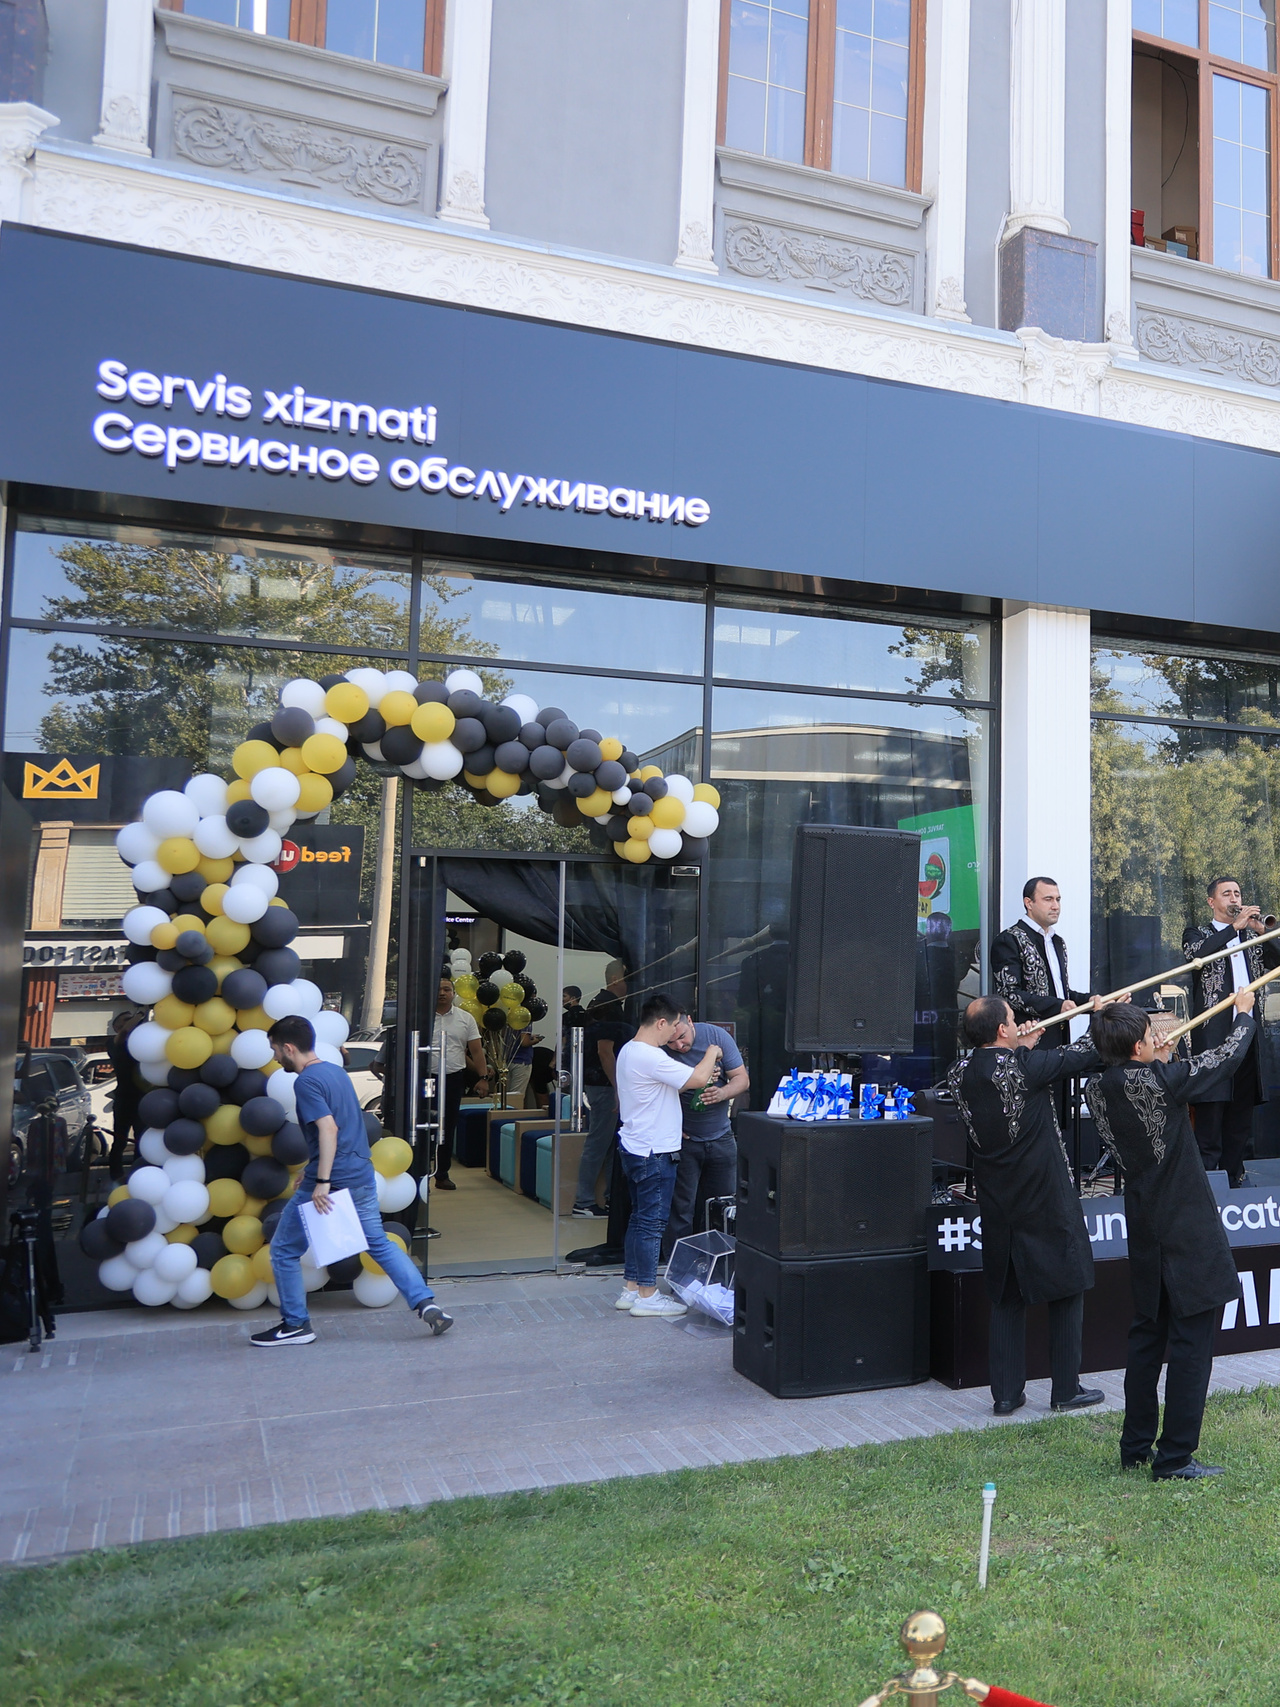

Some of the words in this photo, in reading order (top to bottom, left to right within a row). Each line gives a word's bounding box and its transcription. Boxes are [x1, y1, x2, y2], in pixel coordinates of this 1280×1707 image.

[96, 360, 252, 417] Servis
[263, 386, 438, 444] xizmati
[93, 412, 380, 484] Сервисное
[389, 457, 711, 525] обслуживание
